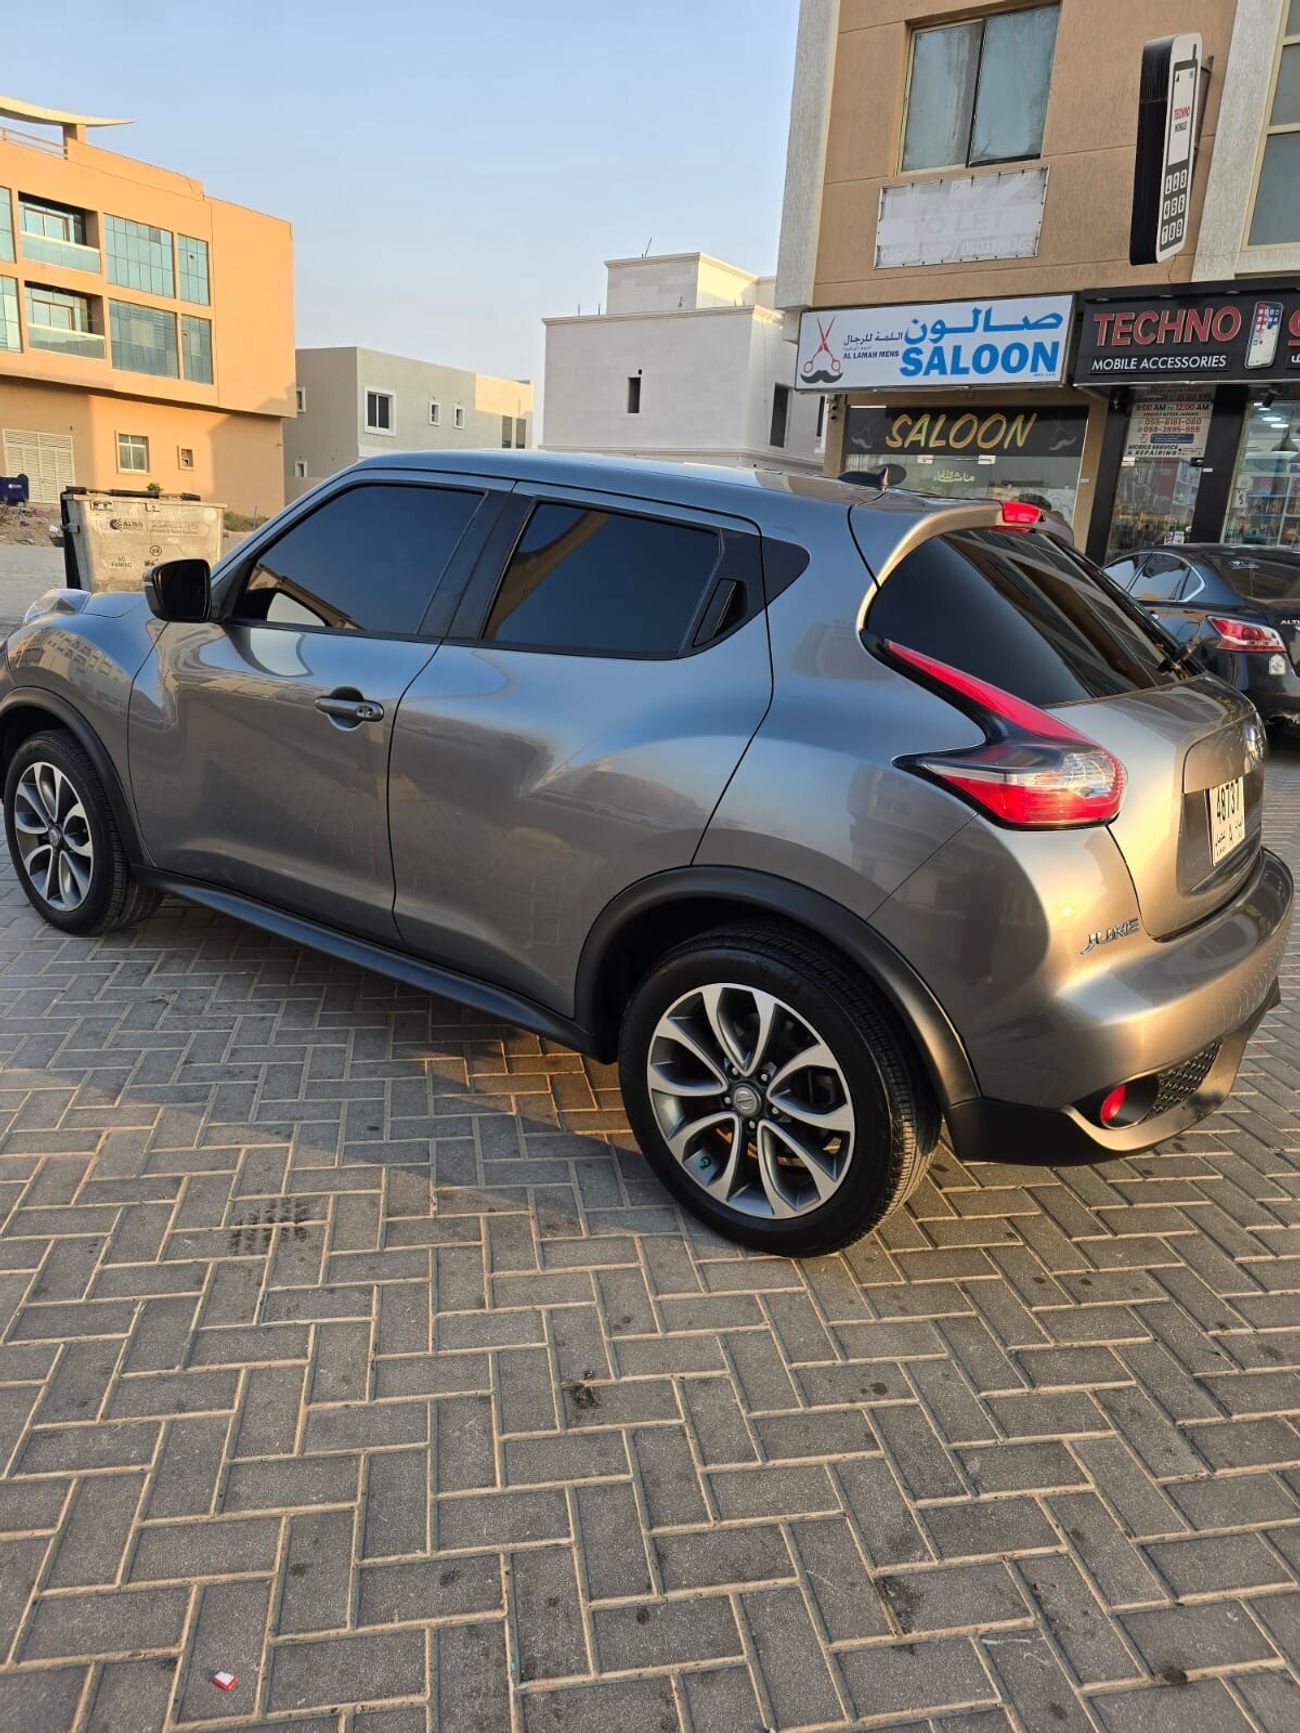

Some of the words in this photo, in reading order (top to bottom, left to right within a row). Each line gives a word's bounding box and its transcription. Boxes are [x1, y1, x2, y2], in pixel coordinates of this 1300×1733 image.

[904, 306, 1064, 345] صالون
[1093, 305, 1242, 347] TECHNO
[899, 341, 1060, 377] SALOON
[1091, 358, 1137, 371] MOBILE
[1139, 355, 1227, 370] ACCESSORIES
[886, 413, 1038, 449] SALOON
[1080, 918, 1140, 955] JUKE
